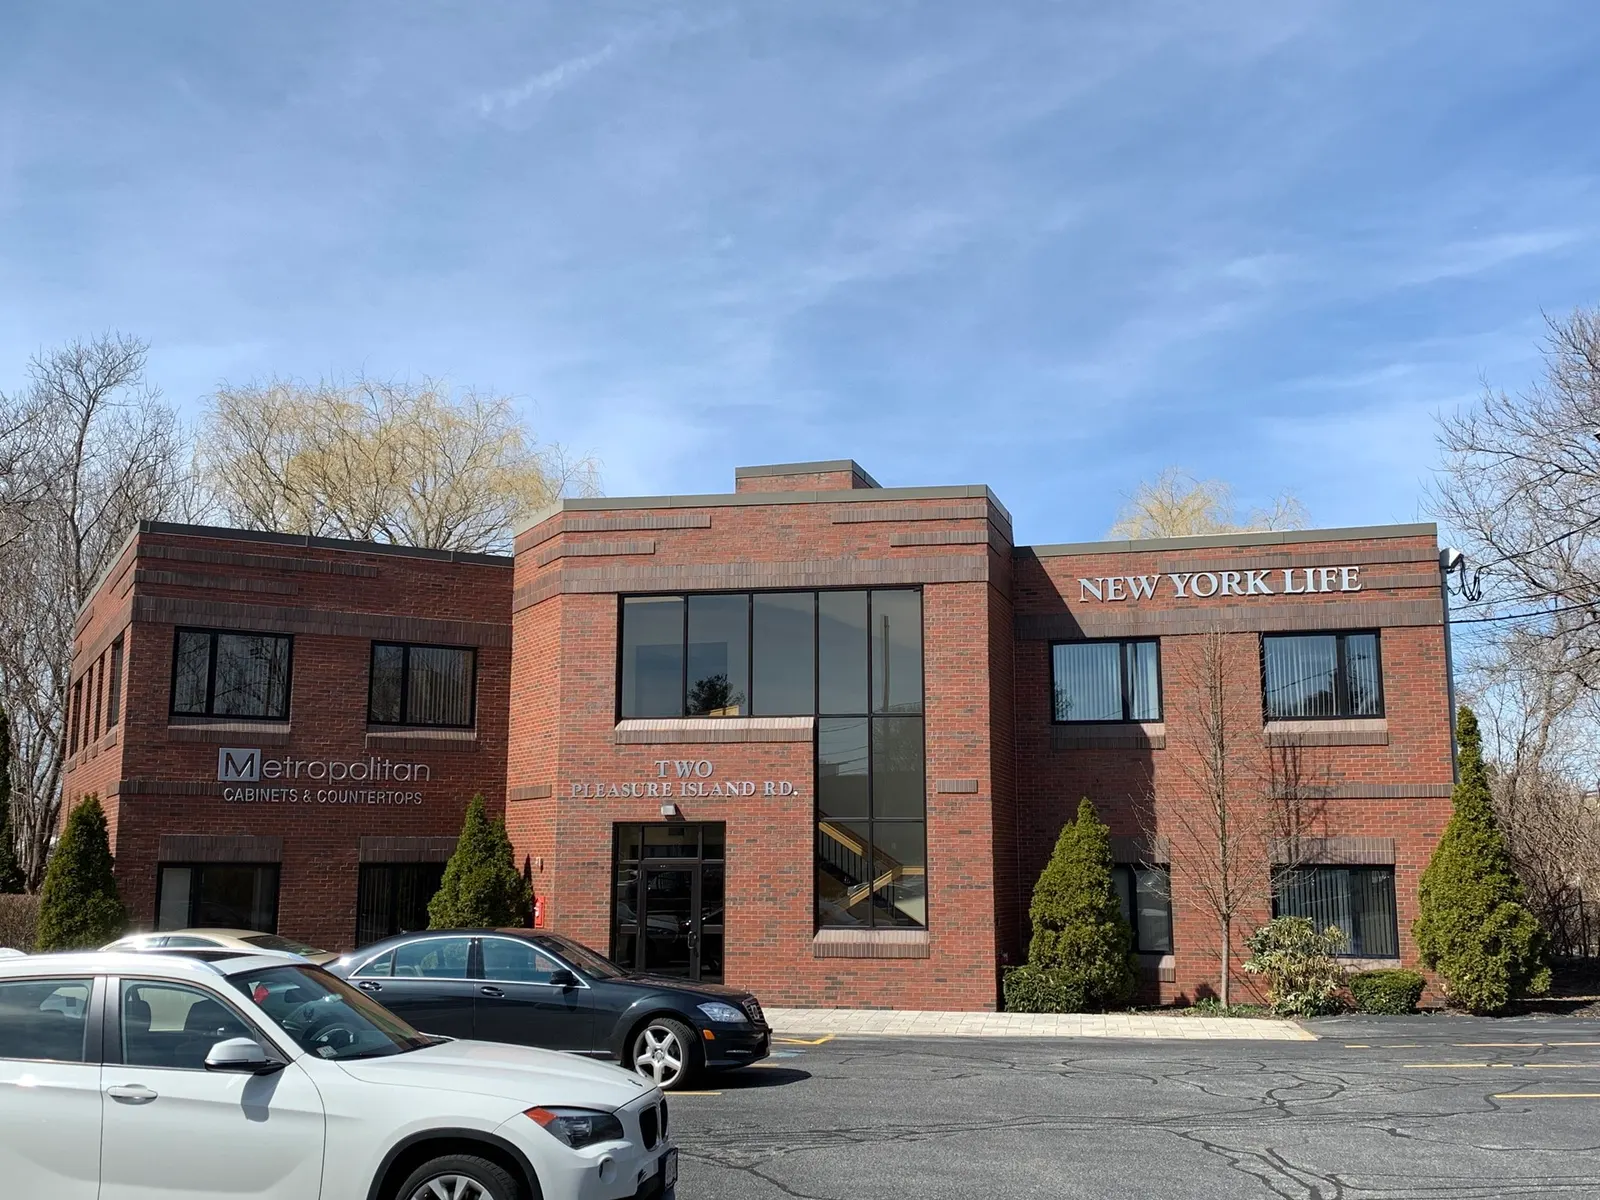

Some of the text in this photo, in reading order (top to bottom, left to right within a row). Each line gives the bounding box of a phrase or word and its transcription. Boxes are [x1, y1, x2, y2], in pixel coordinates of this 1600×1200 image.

[1078, 566, 1362, 603] NEW YORK LIFE
[223, 751, 431, 785] Metropolitan
[655, 760, 713, 779] TWO
[223, 788, 422, 805] CABINETS & COUNTERTOPS
[571, 781, 798, 799] PLEASURE ISLAND RD.
